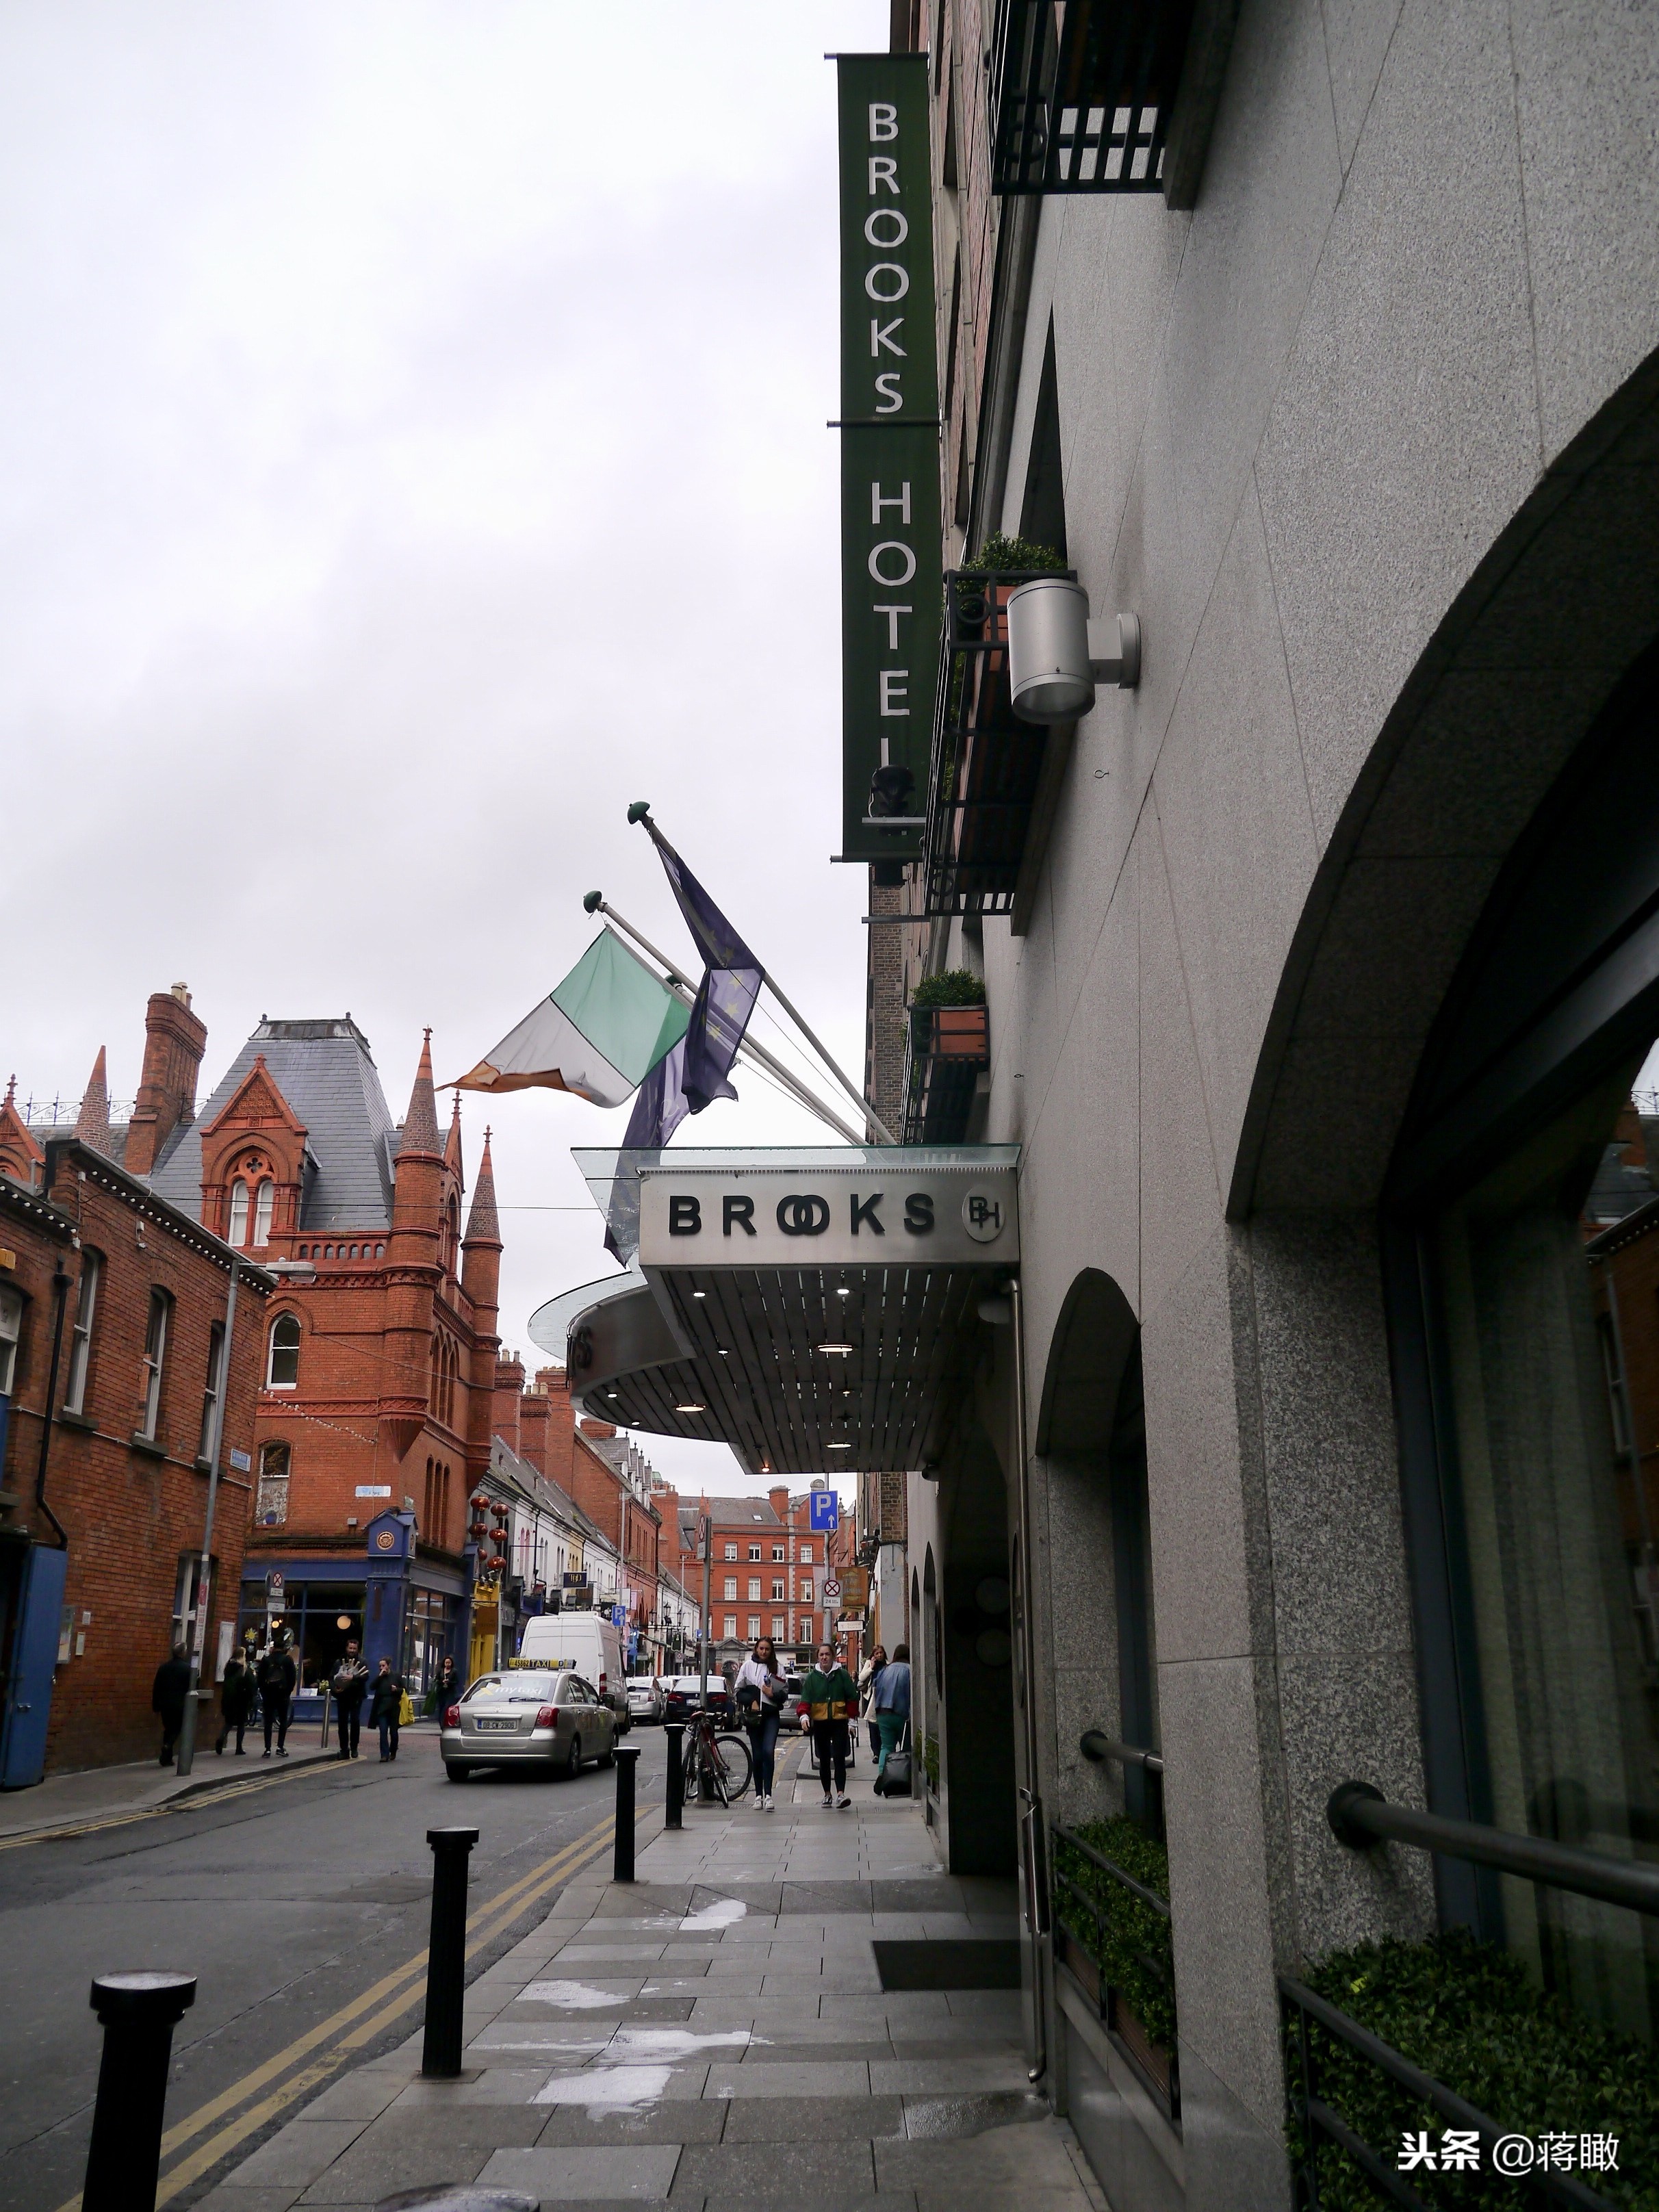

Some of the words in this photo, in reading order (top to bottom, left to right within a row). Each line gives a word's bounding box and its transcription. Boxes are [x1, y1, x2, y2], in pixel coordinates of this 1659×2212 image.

[864, 103, 910, 413] BROOKS
[669, 1192, 936, 1235] BROOKS
[969, 1196, 999, 1229] BH
[816, 1494, 832, 1517] P
[615, 1607, 623, 1619] P
[531, 1659, 550, 1667] TAXI
[496, 1686, 543, 1695] mytaxi
